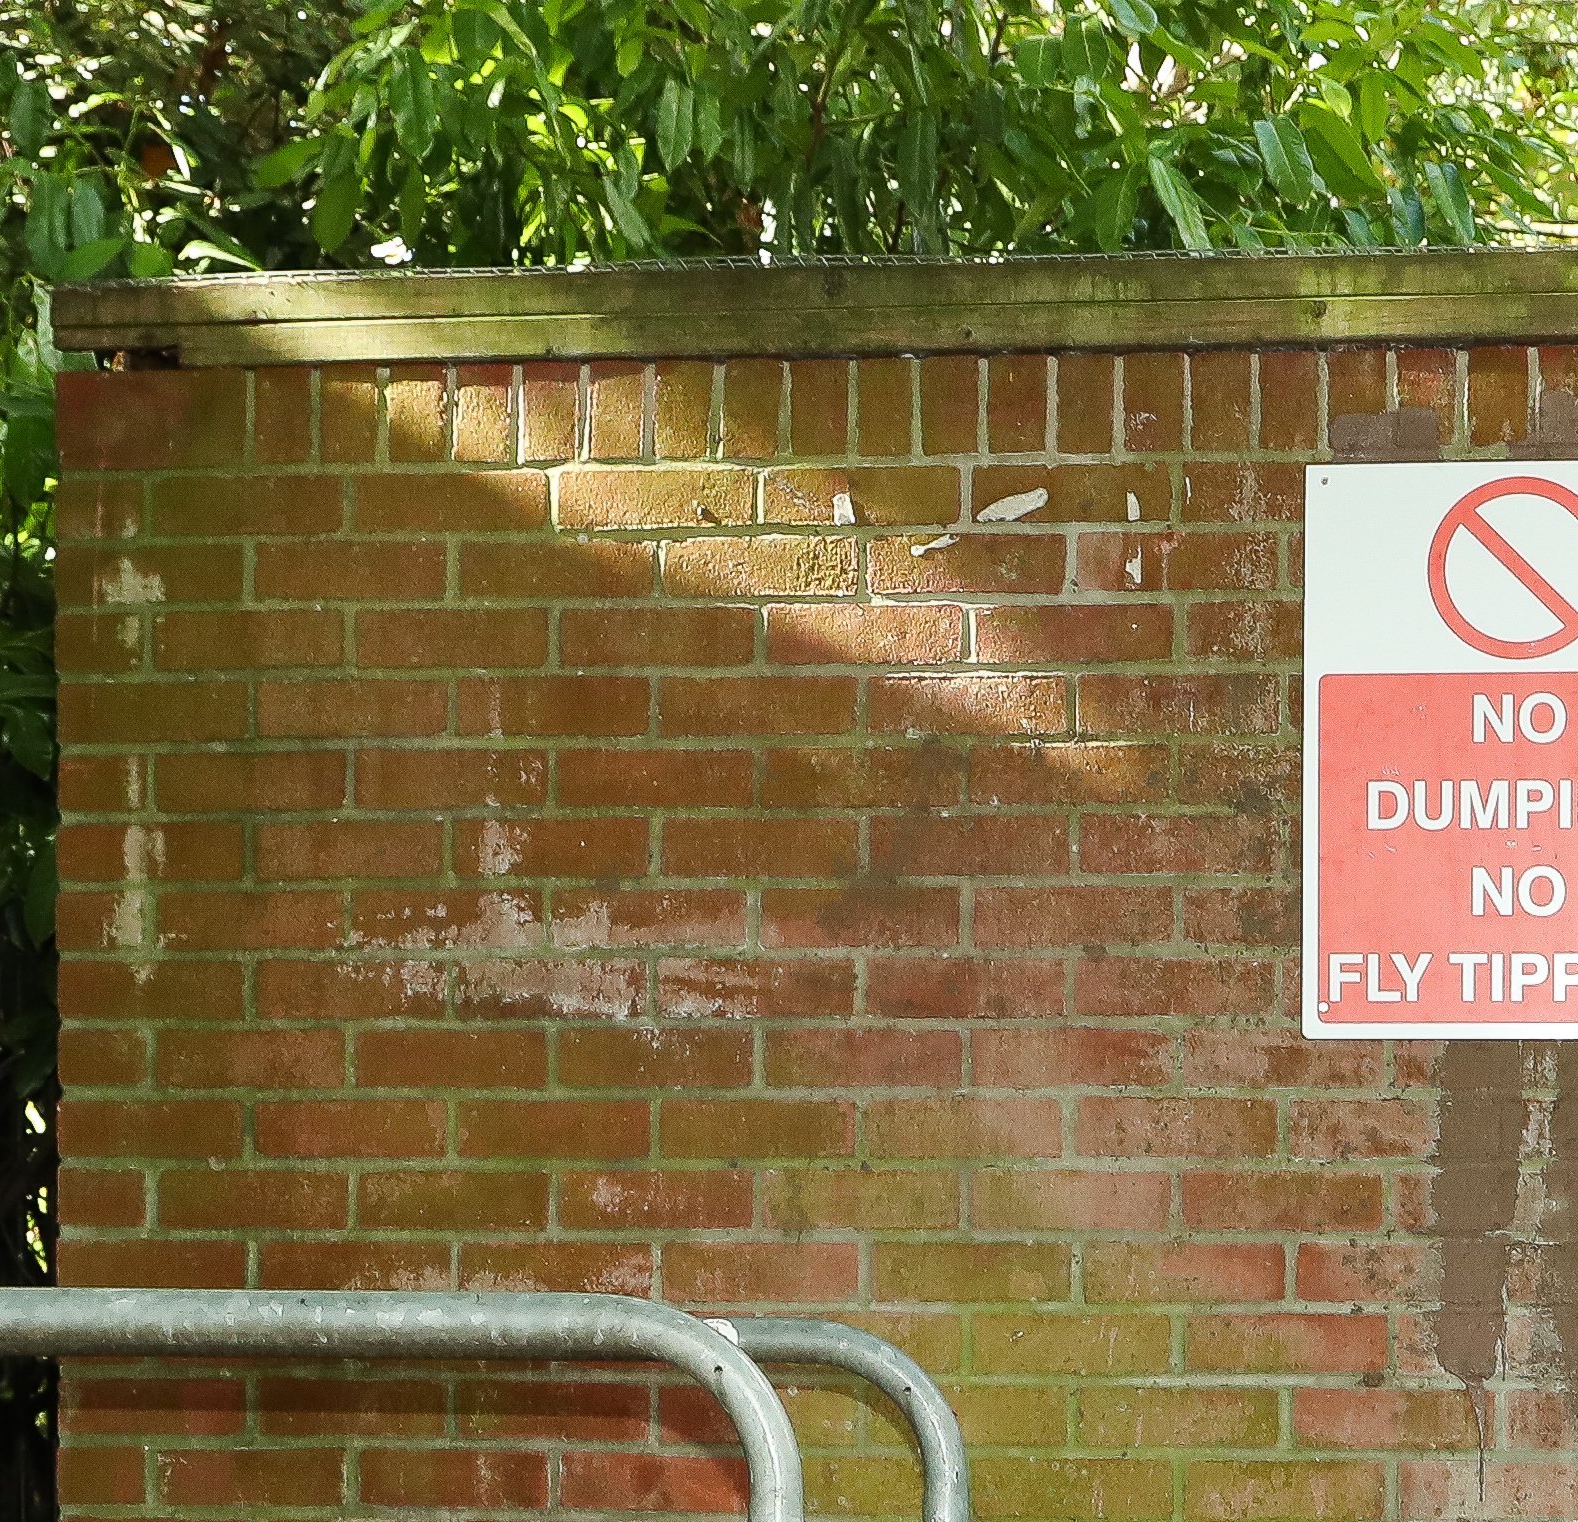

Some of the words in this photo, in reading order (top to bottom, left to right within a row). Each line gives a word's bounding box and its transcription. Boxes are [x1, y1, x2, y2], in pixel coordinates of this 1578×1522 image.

[1471, 691, 1567, 744] NO
[1470, 864, 1567, 917] NO
[1328, 952, 1433, 1003] FLY
